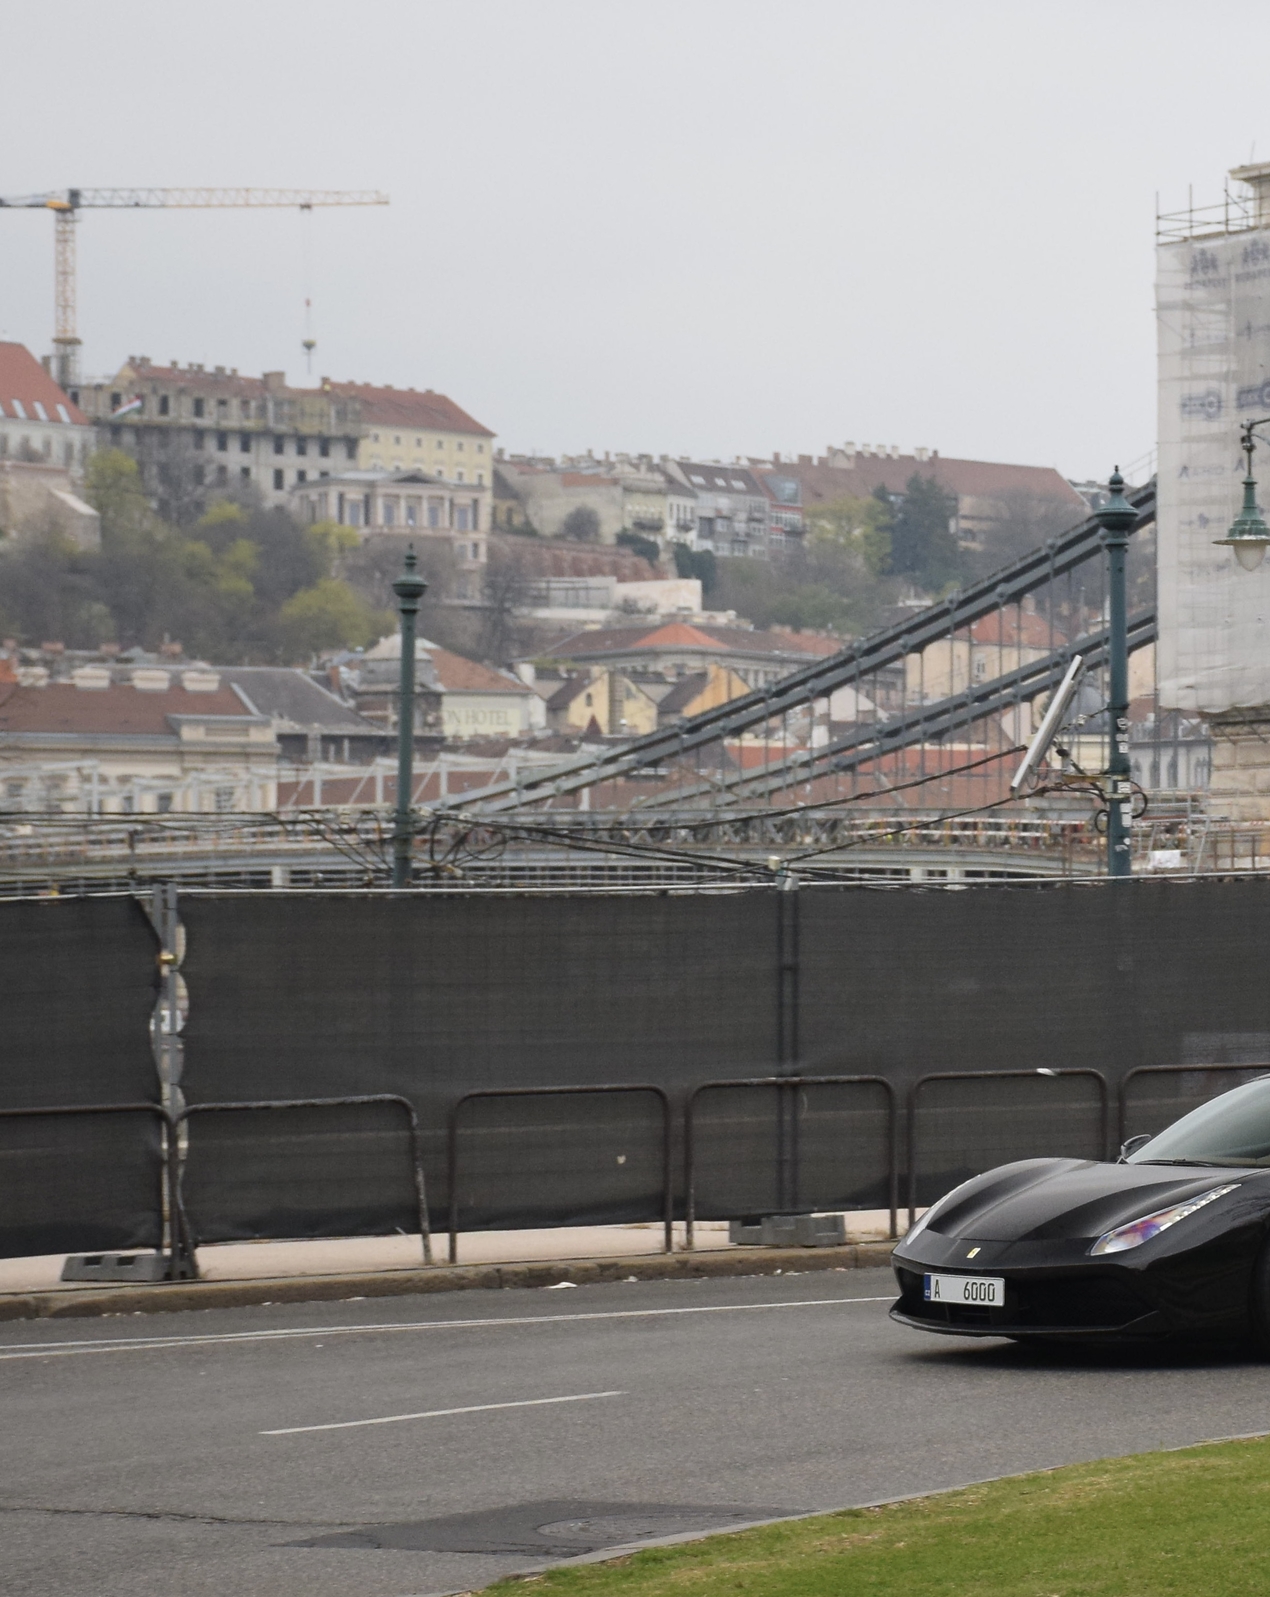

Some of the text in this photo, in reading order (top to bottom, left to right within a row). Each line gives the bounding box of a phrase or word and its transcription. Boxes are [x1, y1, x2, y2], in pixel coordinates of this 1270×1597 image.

[465, 709, 512, 726] HOTEL
[934, 1279, 996, 1302] A 6000
